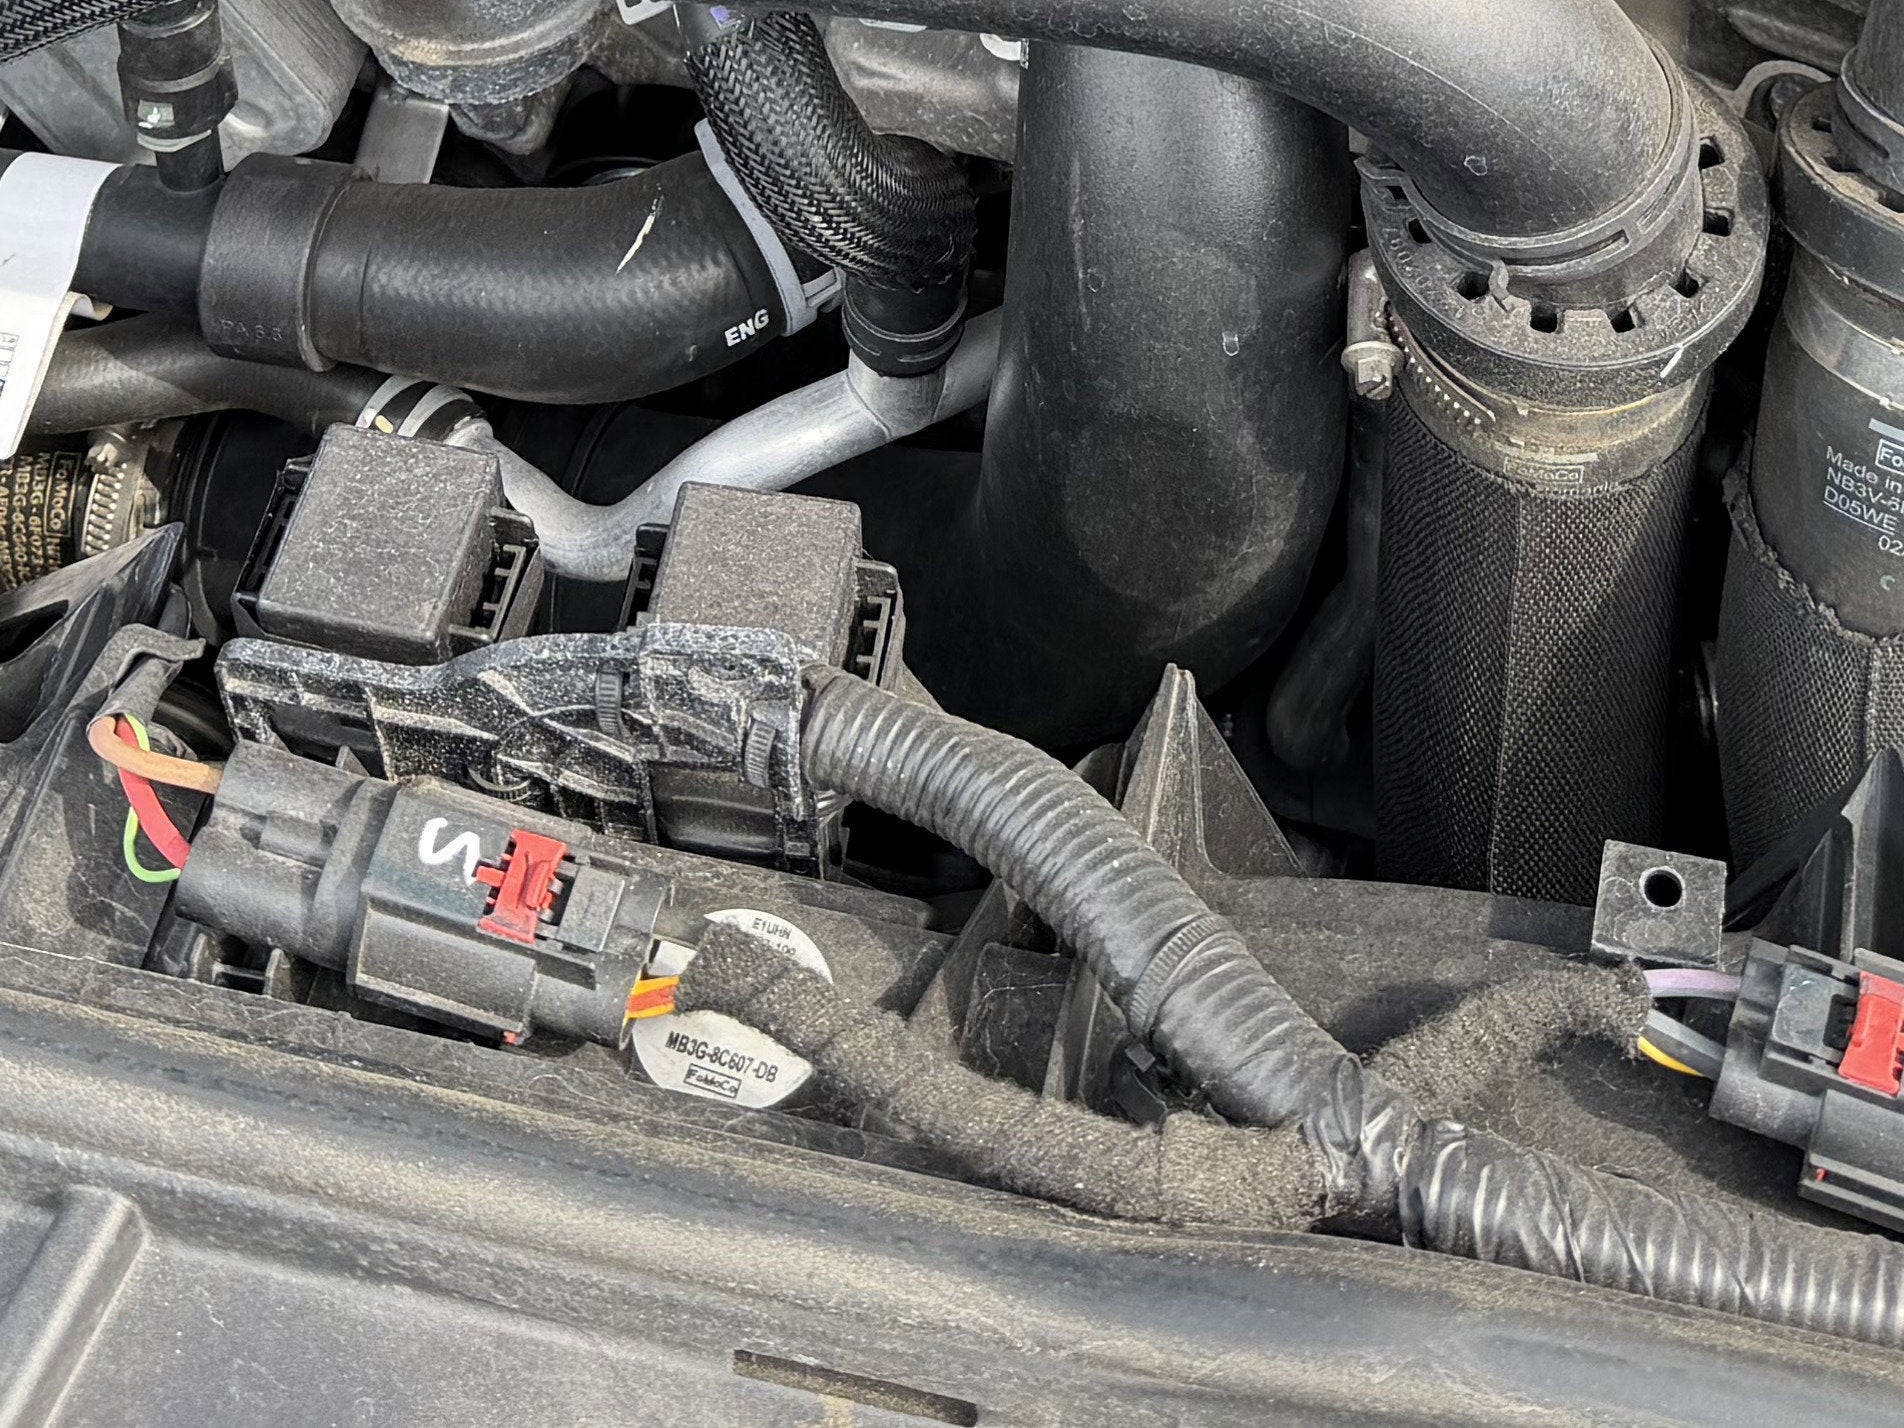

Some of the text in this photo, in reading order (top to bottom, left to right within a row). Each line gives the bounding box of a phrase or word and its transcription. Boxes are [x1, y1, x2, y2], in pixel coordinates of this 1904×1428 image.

[723, 307, 770, 348] ENG
[1826, 445, 1878, 484] Made
[1885, 476, 1902, 494] in
[49, 459, 75, 530] FoMoCo
[1823, 485, 1898, 533] D05WE
[665, 1031, 779, 1084] MB3G-8C607-DB
[687, 1069, 738, 1094] FoMoCo
